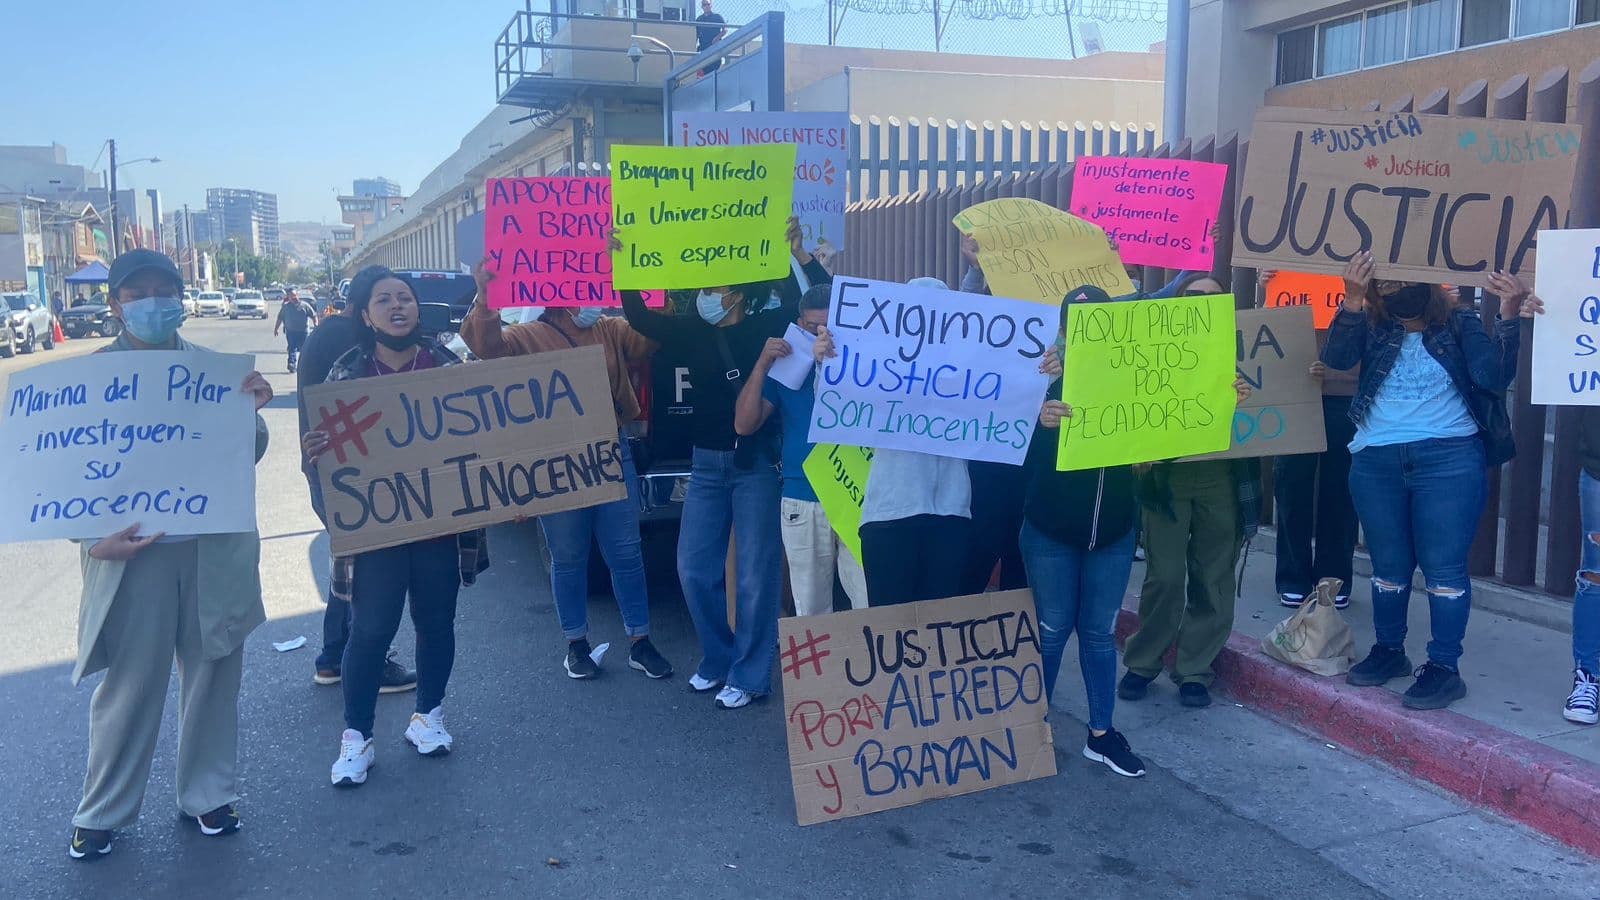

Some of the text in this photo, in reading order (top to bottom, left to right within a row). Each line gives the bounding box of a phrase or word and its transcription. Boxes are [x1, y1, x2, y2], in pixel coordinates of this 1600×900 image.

[703, 160, 768, 181] Alfredo
[1082, 162, 1190, 181] injustamente
[1114, 181, 1196, 200] detenidos
[1239, 131, 1559, 275] JUSTICIA
[502, 210, 613, 239] A BRAY
[649, 195, 769, 225] Universidad
[1091, 201, 1180, 223] justamente
[1102, 226, 1193, 251] efendidos
[1148, 299, 1212, 338] PAGAN
[1110, 340, 1200, 370] JUSTOS
[10, 364, 232, 417] Marina del Pilar
[1135, 368, 1179, 397] POR
[35, 418, 186, 454] investiguen
[817, 390, 1030, 449] Son Inocentes
[1064, 393, 1214, 448] PECADORES
[30, 486, 209, 523] inocencia
[330, 466, 434, 532] SON
[883, 662, 1044, 730] ALFREDO
[853, 727, 1018, 796] BRAYAN
